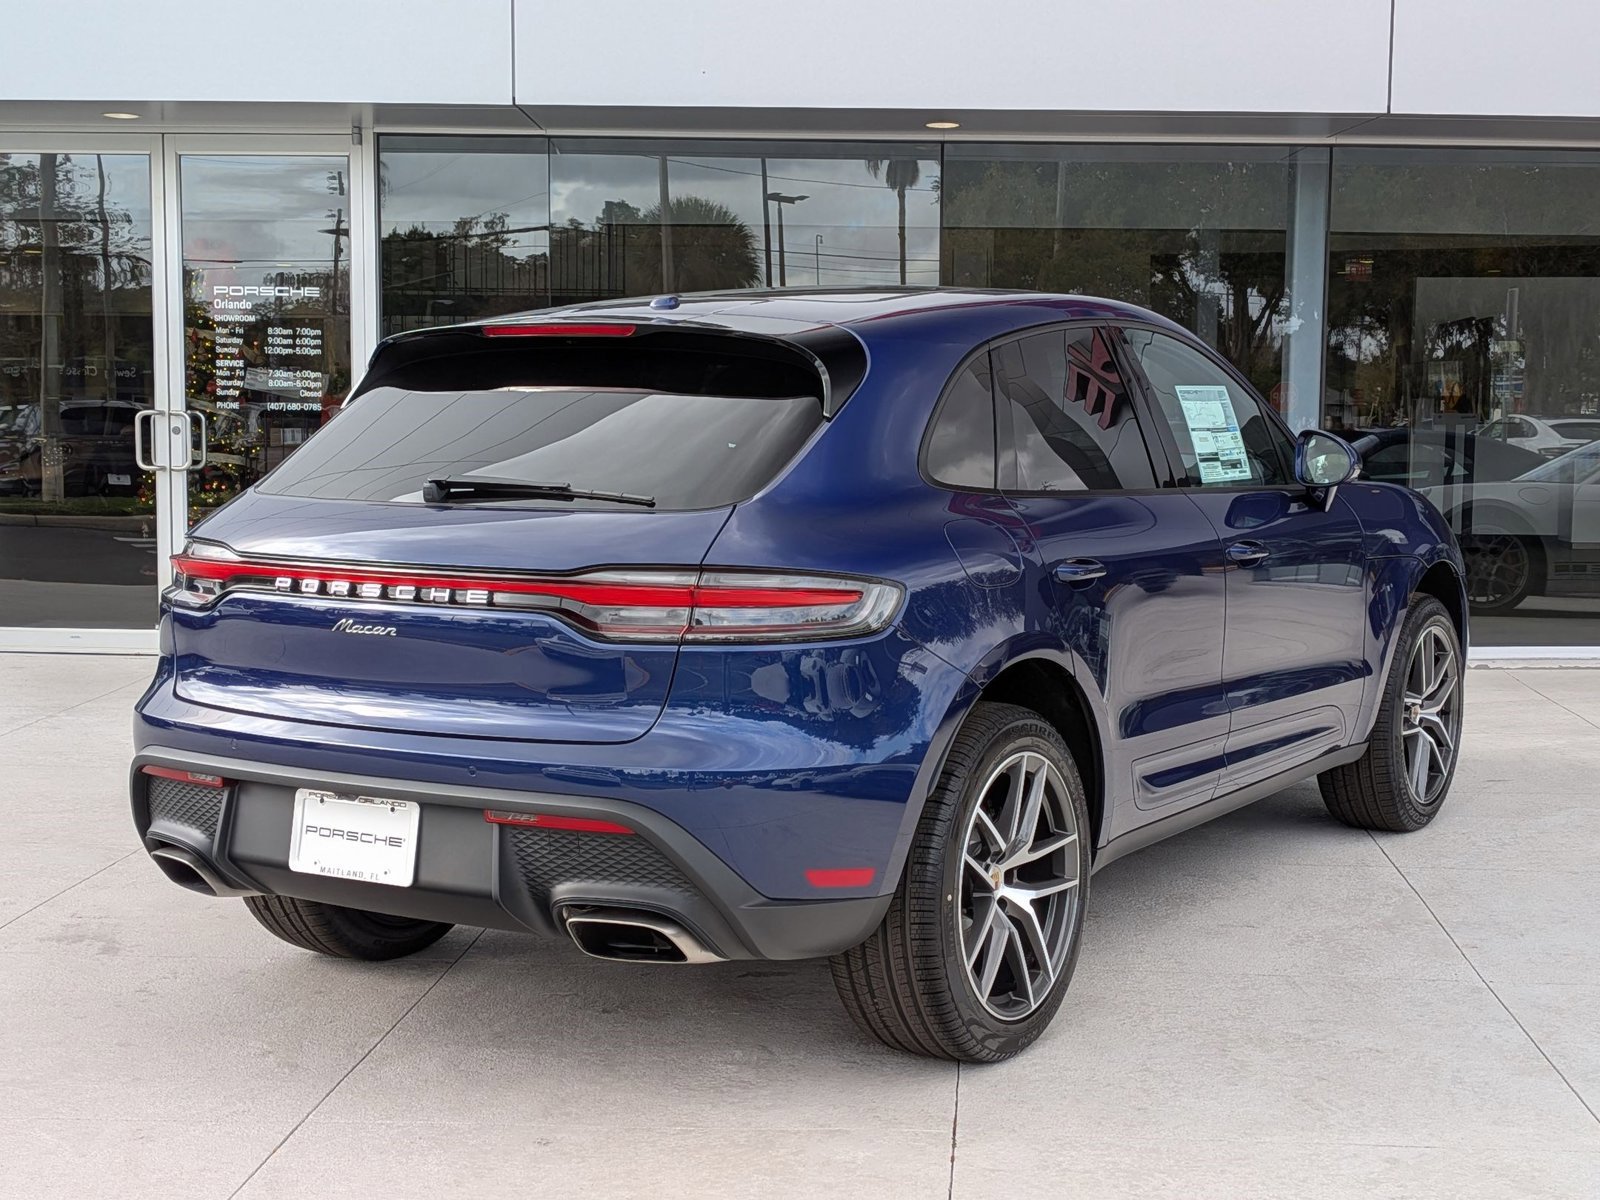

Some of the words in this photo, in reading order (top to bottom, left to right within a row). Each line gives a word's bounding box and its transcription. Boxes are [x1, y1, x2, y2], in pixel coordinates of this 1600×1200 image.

[213, 286, 320, 297] PORSCHE
[213, 299, 252, 309] Orlando
[213, 314, 256, 322] SHOWROOM
[267, 327, 293, 335] 8:30am
[295, 327, 322, 337] 7:00pm
[215, 336, 244, 345] Saturday
[267, 337, 293, 345] 9:00am
[295, 337, 322, 346] 6:00pm
[215, 346, 239, 354] Sunday
[215, 369, 230, 377] Mon
[235, 369, 245, 377] Fri
[215, 379, 244, 388] Saturday
[216, 388, 240, 397] Sunday
[299, 389, 322, 397] Closed
[267, 402, 286, 411] (407)
[274, 577, 490, 604] PORSCHE
[331, 618, 397, 636] Macan
[358, 797, 407, 809] ORLANDO
[305, 825, 403, 848] PORSCHE
[319, 866, 366, 879] MAITLAND,
[370, 872, 379, 881] FL
